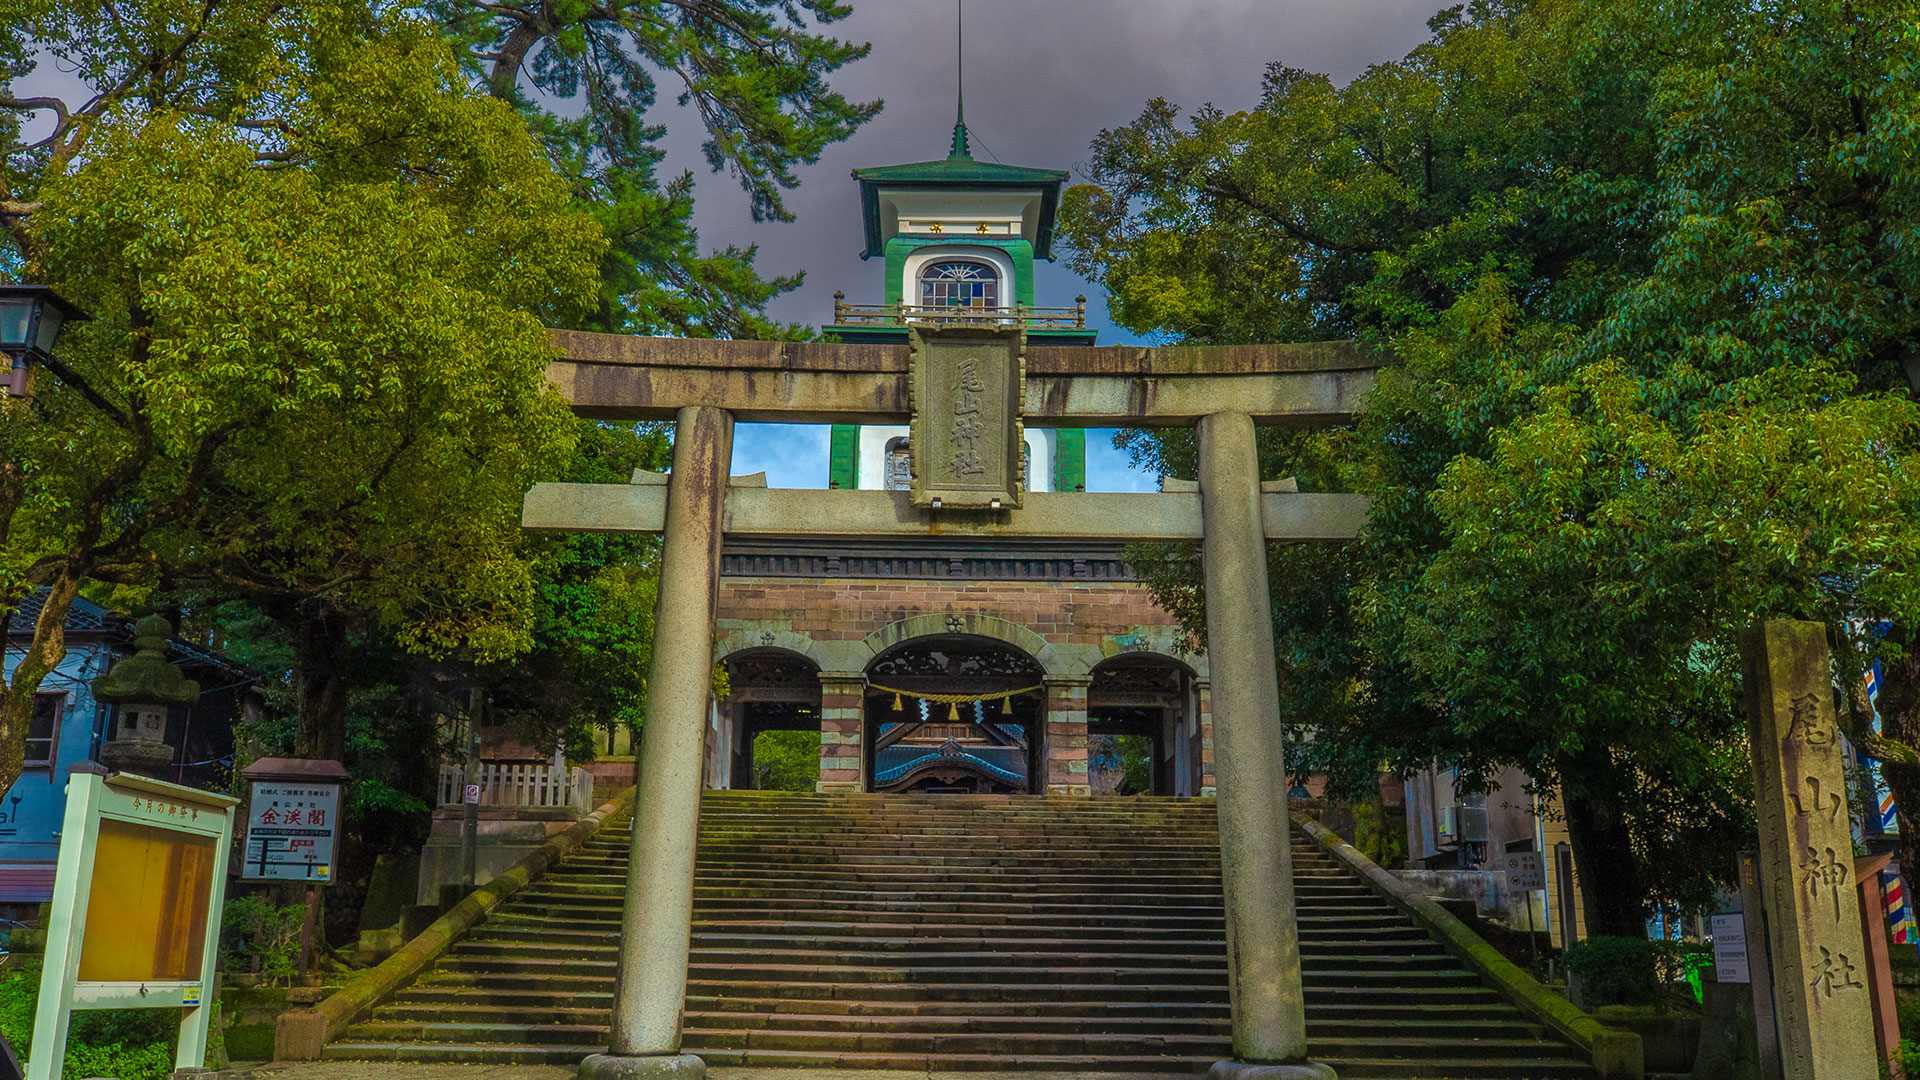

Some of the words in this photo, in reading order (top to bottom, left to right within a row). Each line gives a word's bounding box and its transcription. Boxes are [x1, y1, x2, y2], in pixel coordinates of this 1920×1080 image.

[951, 358, 985, 478] 尾山神社
[260, 807, 325, 827] 金渓閣
[1786, 692, 1864, 998] 尾山神社
